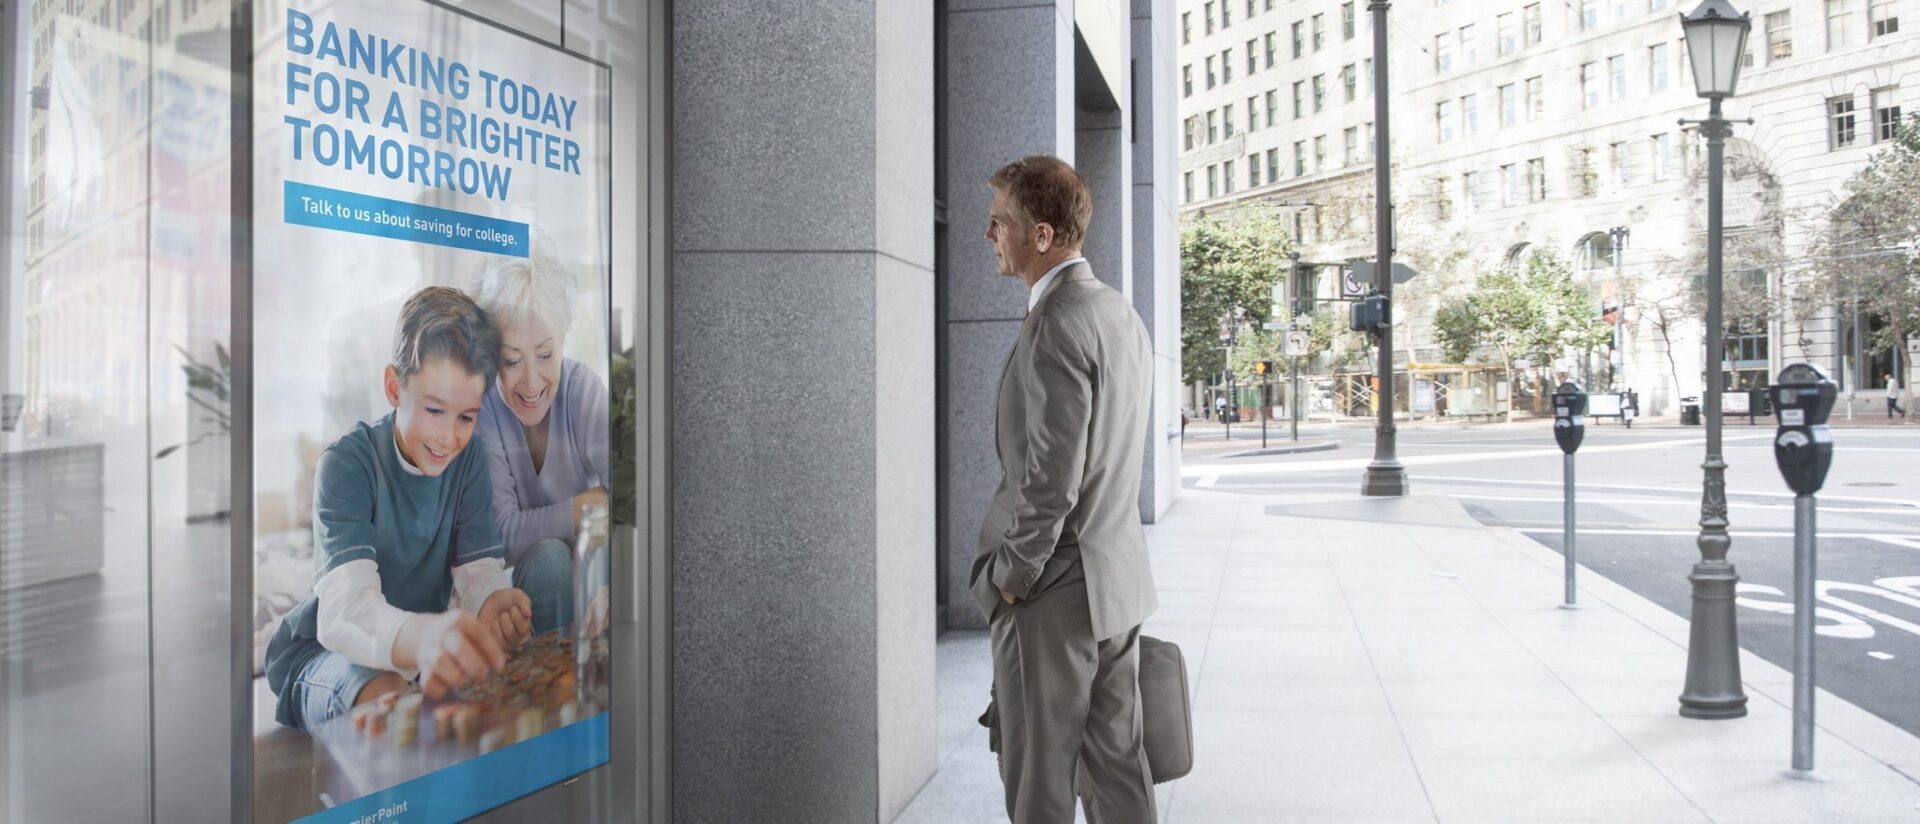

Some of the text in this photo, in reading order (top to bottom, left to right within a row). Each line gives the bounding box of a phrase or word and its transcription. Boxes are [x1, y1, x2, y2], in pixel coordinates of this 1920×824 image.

[286, 62, 581, 175] FOR A BRIGHTER
[287, 8, 577, 131] BANKING TODAY
[284, 115, 512, 201] TOMORROW
[302, 196, 518, 247] Talk to us about saving for college.
